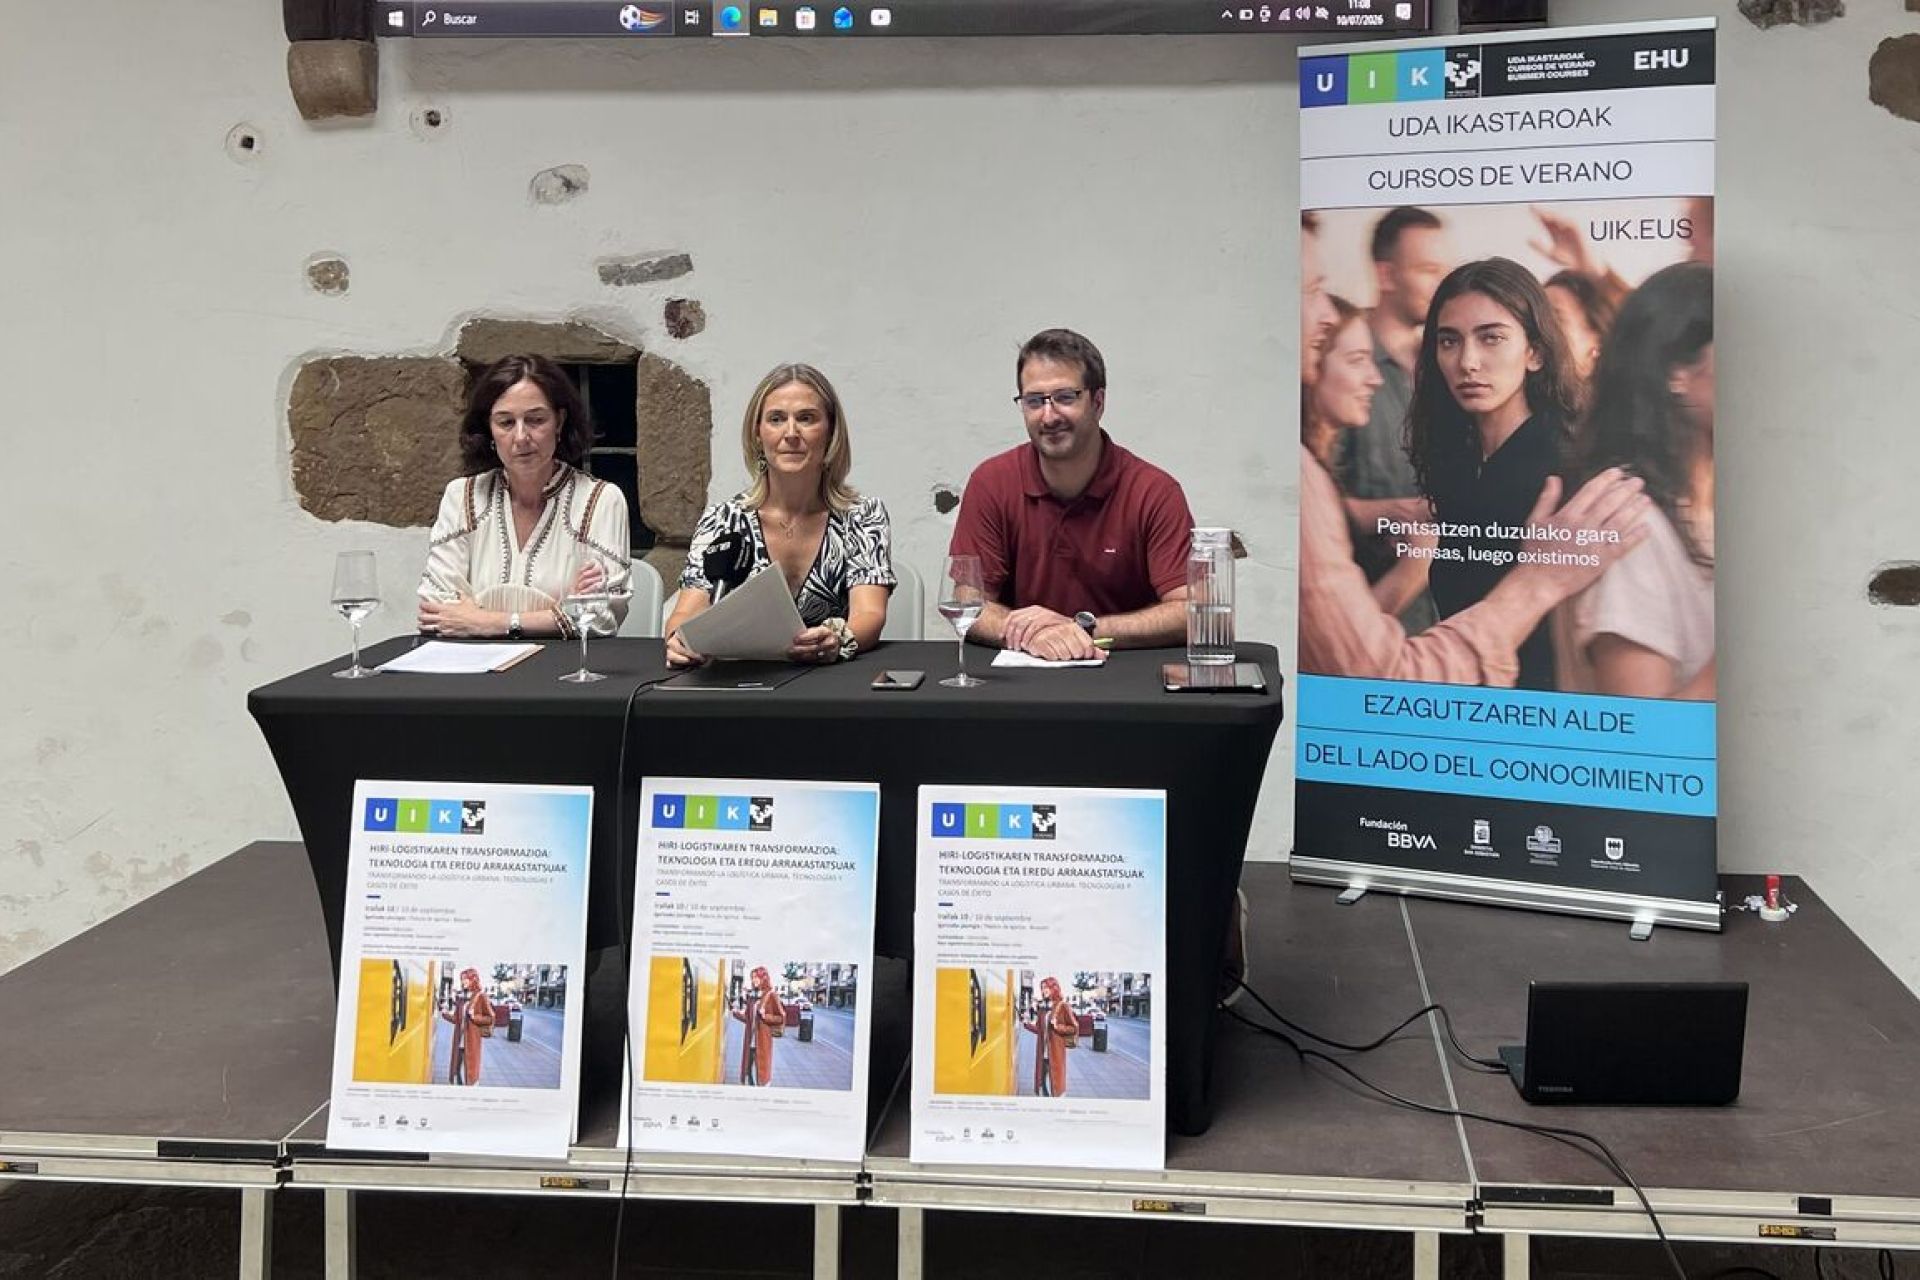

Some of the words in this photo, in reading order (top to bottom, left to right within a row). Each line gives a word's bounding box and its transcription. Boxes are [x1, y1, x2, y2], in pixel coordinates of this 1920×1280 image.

[443, 11, 478, 26] Buscar
[1633, 48, 1689, 71] EHU
[1388, 114, 1441, 138] UDA
[1446, 106, 1612, 135] IKASTAROAK
[1367, 166, 1474, 191] CURSOS
[1480, 165, 1514, 187] DE
[1519, 160, 1633, 185] VERANO
[1589, 217, 1693, 242] UIK.EUS
[1377, 517, 1481, 538] Pentsatzen
[1485, 521, 1572, 541] duzulako
[1575, 527, 1620, 546] gara
[1396, 543, 1465, 562] Piensas,
[1467, 546, 1514, 566] luego
[1517, 550, 1600, 567] existimos
[1364, 693, 1558, 729] EZAGUTZAREN
[1563, 708, 1636, 735] ALDE
[1304, 742, 1352, 767] DEL
[1357, 748, 1428, 773] LADO
[1434, 755, 1484, 778] DEL
[1489, 758, 1704, 797] CONOCIMIENTO
[1359, 817, 1408, 831] Fundación
[1387, 832, 1437, 850] BBVA
[369, 859, 428, 869] TEKNOLOGIA
[430, 860, 447, 869] ETA
[450, 861, 481, 871] EREDU
[483, 862, 568, 873] ARRAKASTATSUAK
[657, 855, 717, 866] TEKNOLOGIA
[719, 857, 736, 867] ETA
[738, 857, 769, 868] EREDU
[771, 859, 857, 871] ARRAKASTATSUAK
[938, 865, 1000, 876] TEKNOLOGIA
[1003, 866, 1020, 876] ETA
[1022, 867, 1054, 878] EREDU
[1057, 868, 1145, 880] ARRAKASTATSUAK
